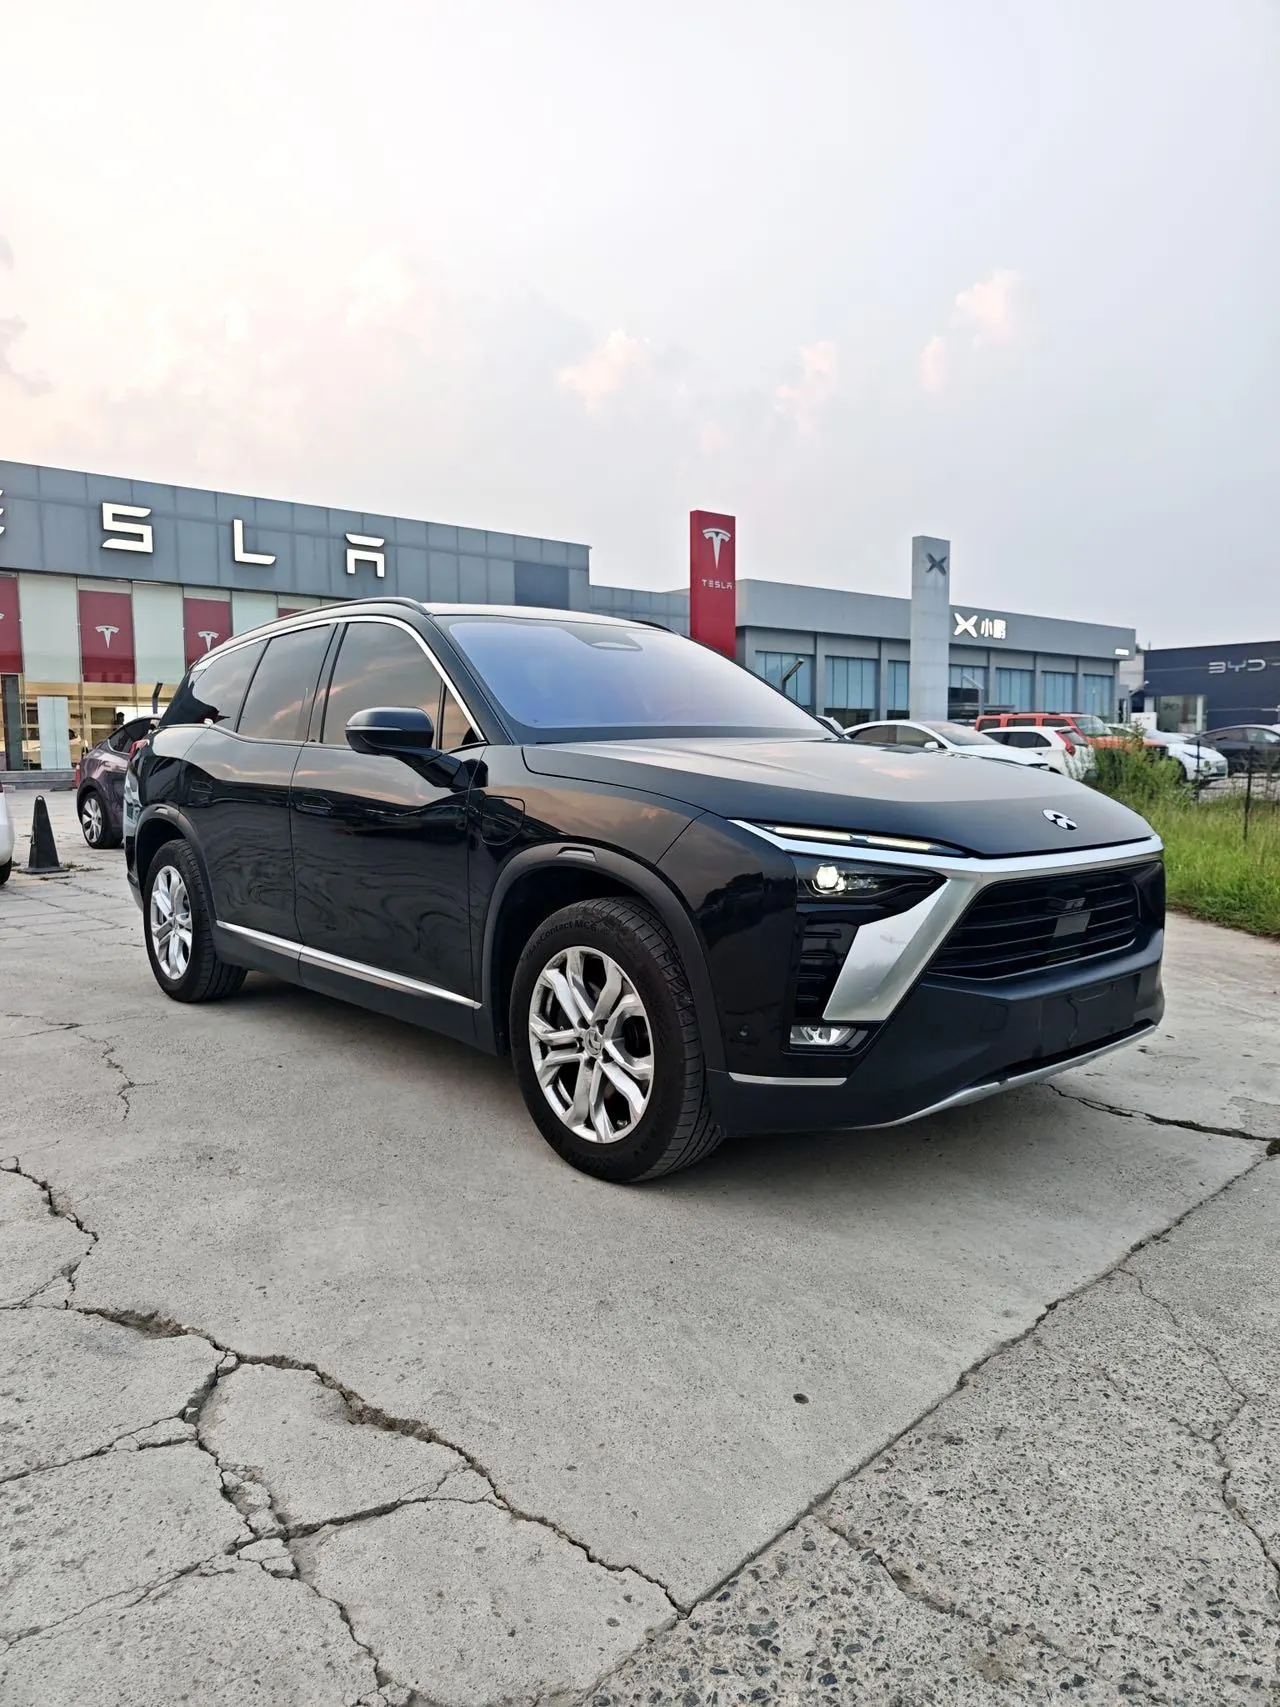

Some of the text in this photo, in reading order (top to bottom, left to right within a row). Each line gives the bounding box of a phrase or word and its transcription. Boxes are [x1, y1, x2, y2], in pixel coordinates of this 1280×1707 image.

[0, 489, 385, 578] SLA
[702, 579, 733, 589] TESLA
[1208, 659, 1266, 674] BYD
